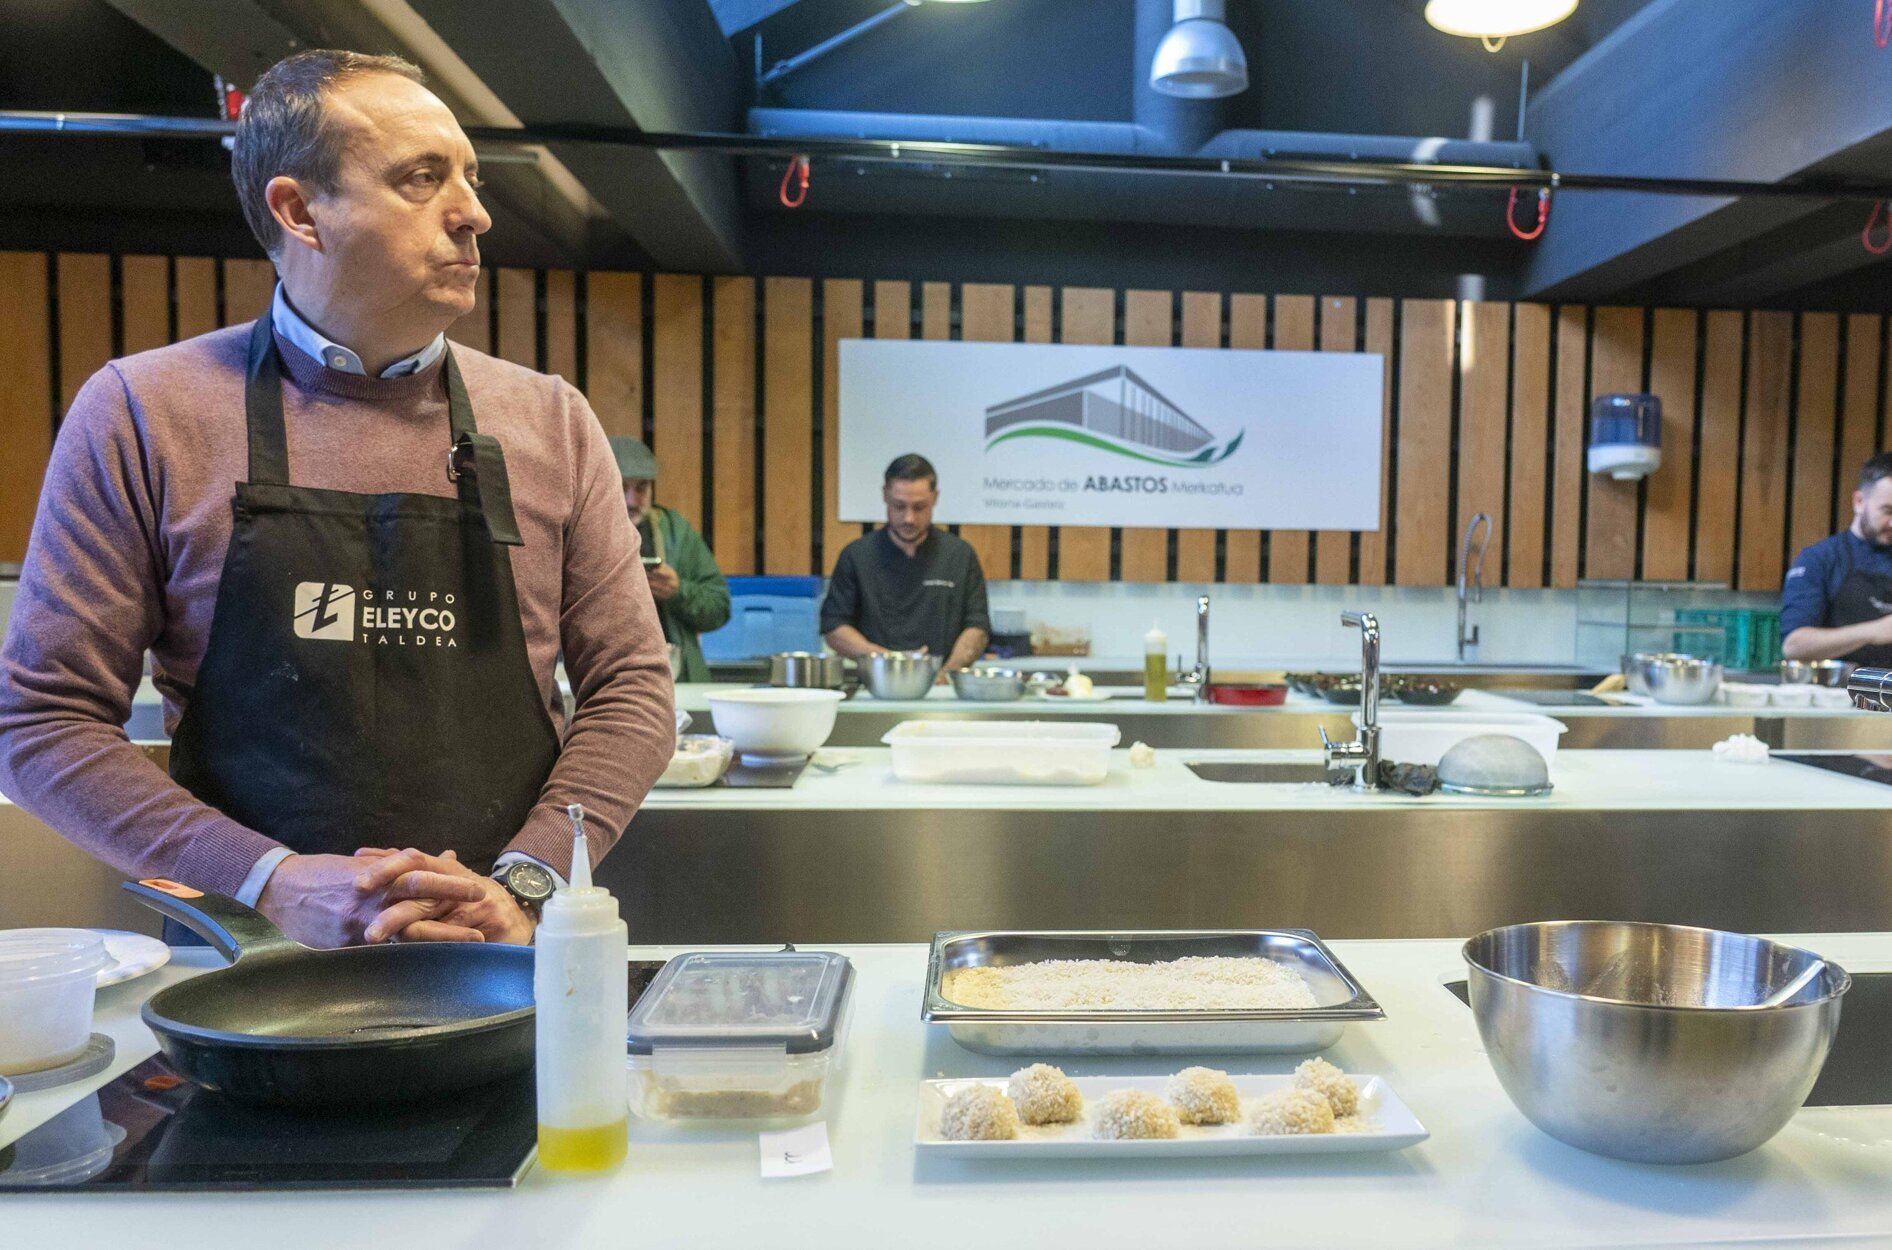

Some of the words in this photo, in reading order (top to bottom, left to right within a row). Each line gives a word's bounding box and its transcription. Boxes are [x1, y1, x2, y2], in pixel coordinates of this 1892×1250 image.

[983, 476, 1054, 492] Mercado
[1059, 477, 1077, 492] de
[1083, 474, 1168, 494] ABASTOS
[1171, 480, 1244, 497] Merkatua
[363, 590, 455, 604] GRUPO
[363, 606, 456, 631] ELEYCO
[363, 634, 457, 647] TALDEA
